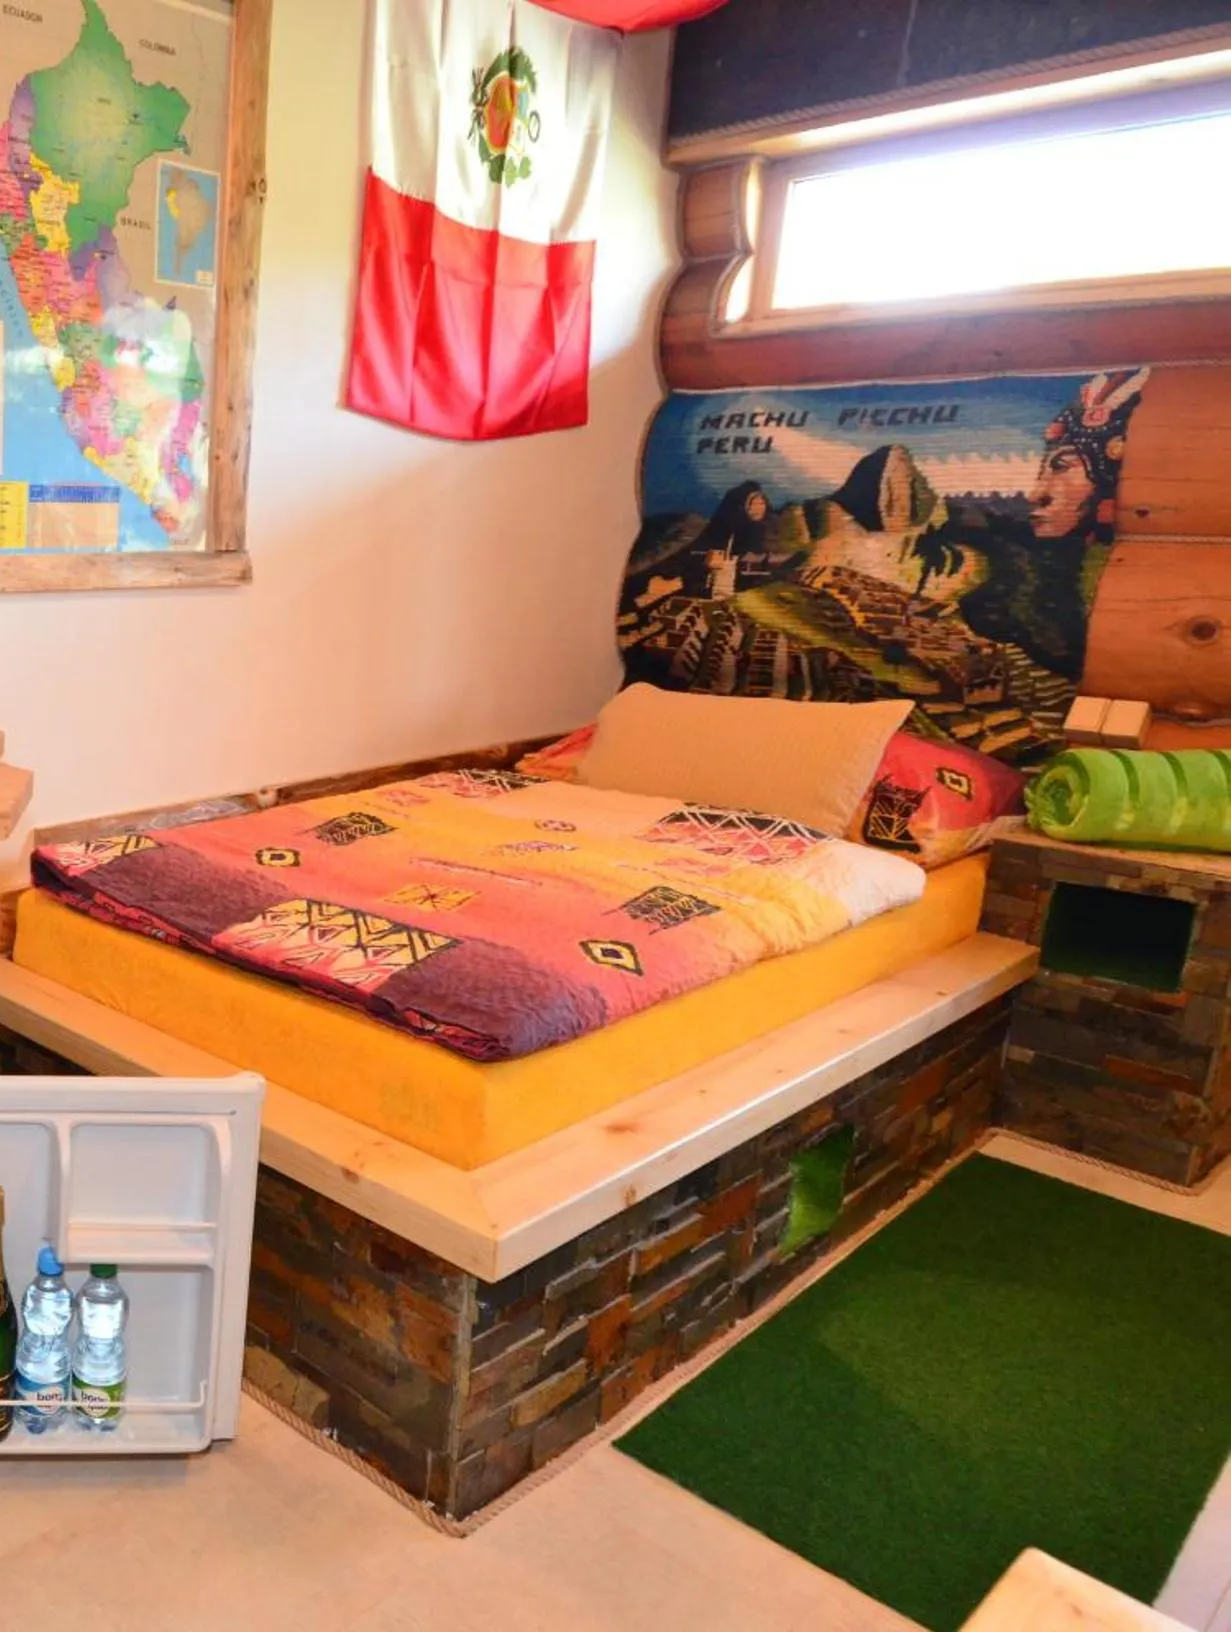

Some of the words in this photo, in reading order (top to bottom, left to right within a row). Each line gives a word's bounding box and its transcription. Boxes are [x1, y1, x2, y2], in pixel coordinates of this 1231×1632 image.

[2, 4, 43, 23] ECUADOR
[699, 411, 809, 430] MACHU
[837, 404, 961, 426] PICCHU
[696, 436, 773, 455] PERU
